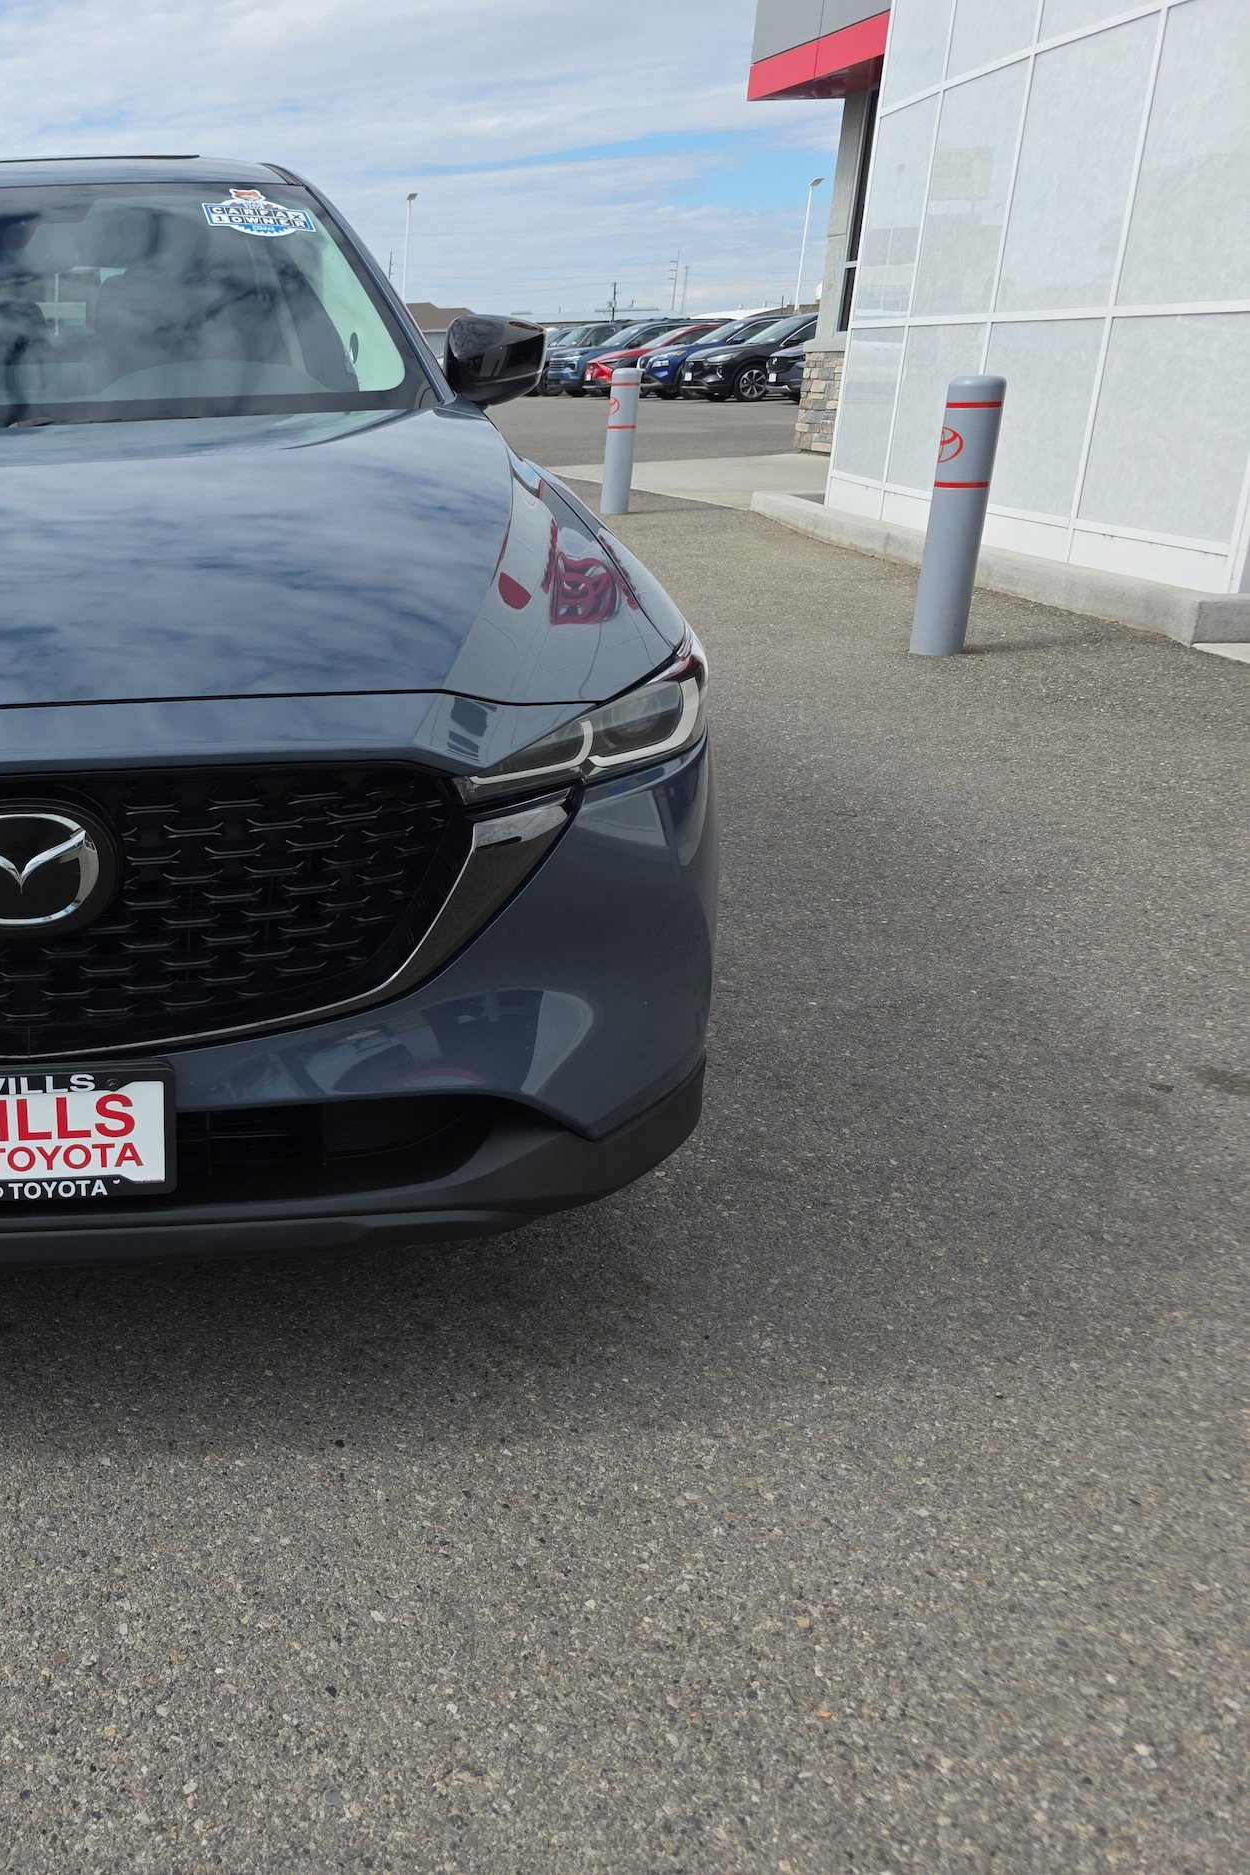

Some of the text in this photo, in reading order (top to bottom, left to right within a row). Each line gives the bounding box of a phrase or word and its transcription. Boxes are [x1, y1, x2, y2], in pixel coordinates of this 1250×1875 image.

[211, 207, 303, 220] CARFAX
[229, 216, 306, 228] OWNER
[8, 1179, 108, 1200] TOYOTA
